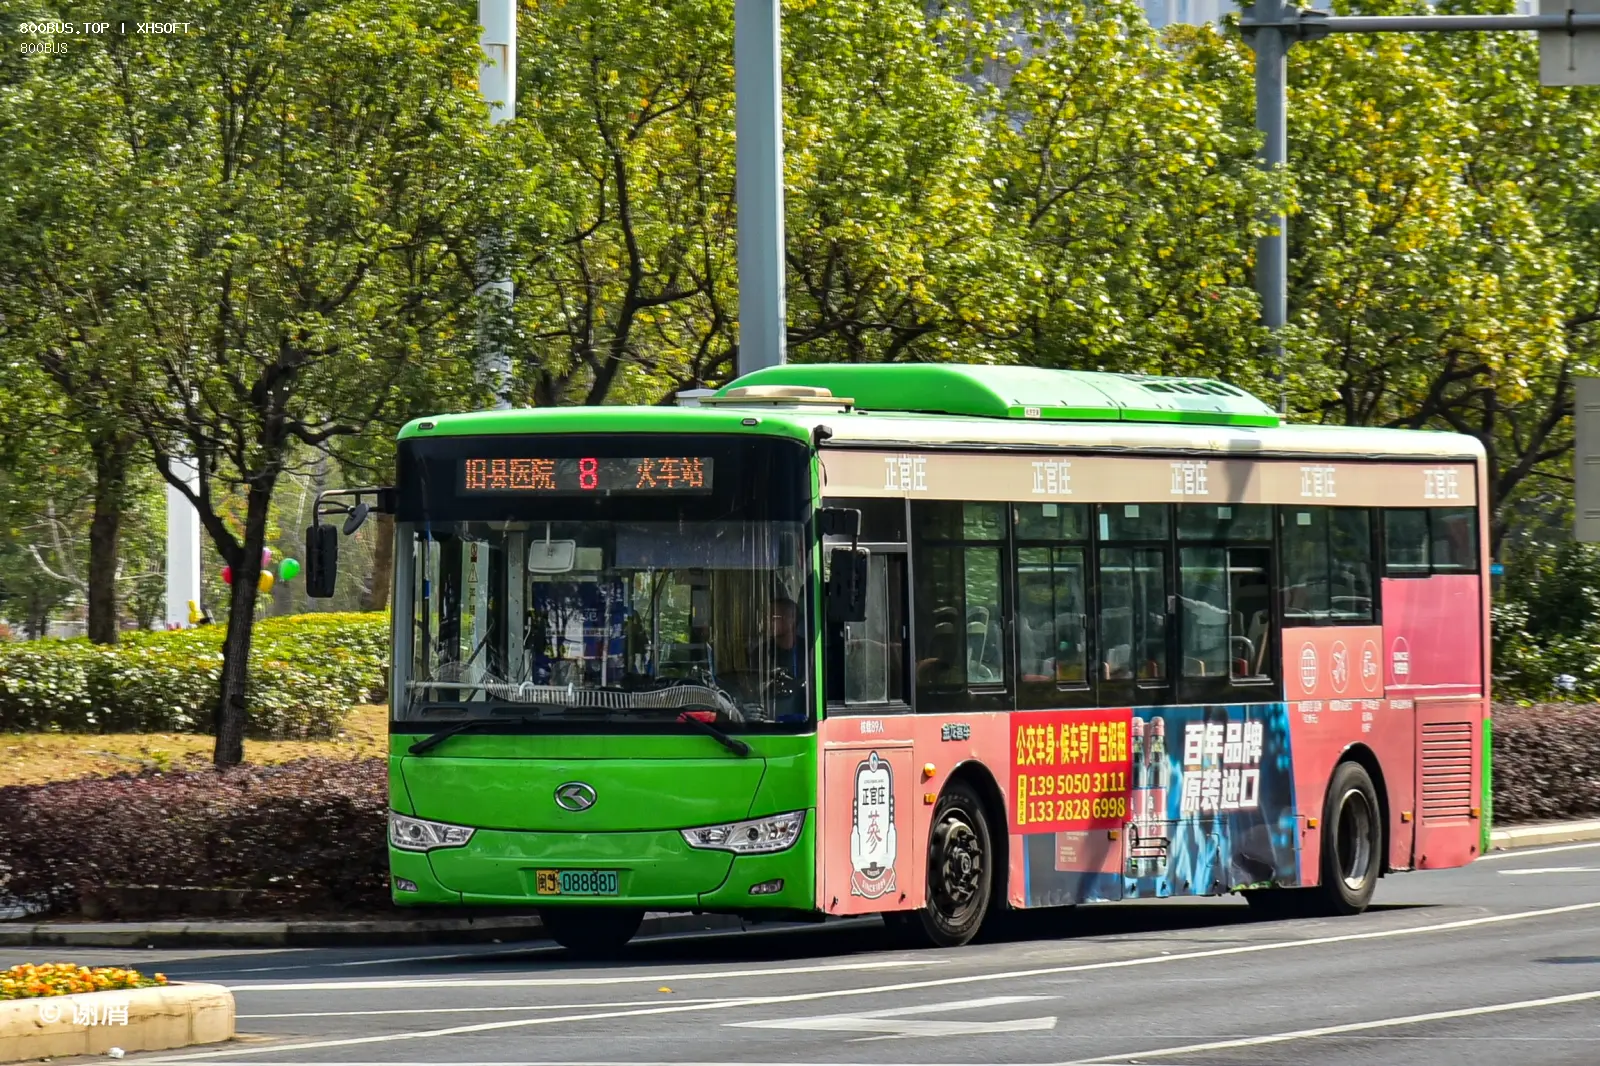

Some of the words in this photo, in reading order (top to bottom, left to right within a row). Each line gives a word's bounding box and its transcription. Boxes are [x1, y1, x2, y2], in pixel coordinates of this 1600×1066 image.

[465, 459, 556, 490] 旧县医院
[579, 457, 597, 490] 8
[636, 456, 704, 489] 火车站
[884, 453, 928, 492] 正官庄
[1031, 458, 1073, 495] 正官庄
[1170, 460, 1209, 495] 正官庄
[1301, 463, 1337, 498] 正官庄
[1424, 465, 1460, 499] 正官庄
[1183, 721, 1264, 766] 百年品牌
[862, 785, 886, 806] 正官庄
[1029, 775, 1055, 797] 139
[1057, 773, 1091, 795] 5050
[1092, 771, 1126, 792] 3111
[1180, 768, 1260, 815] 原装进口
[1028, 800, 1054, 822] 133
[1056, 798, 1090, 821] 2828
[1092, 796, 1126, 818] 6998
